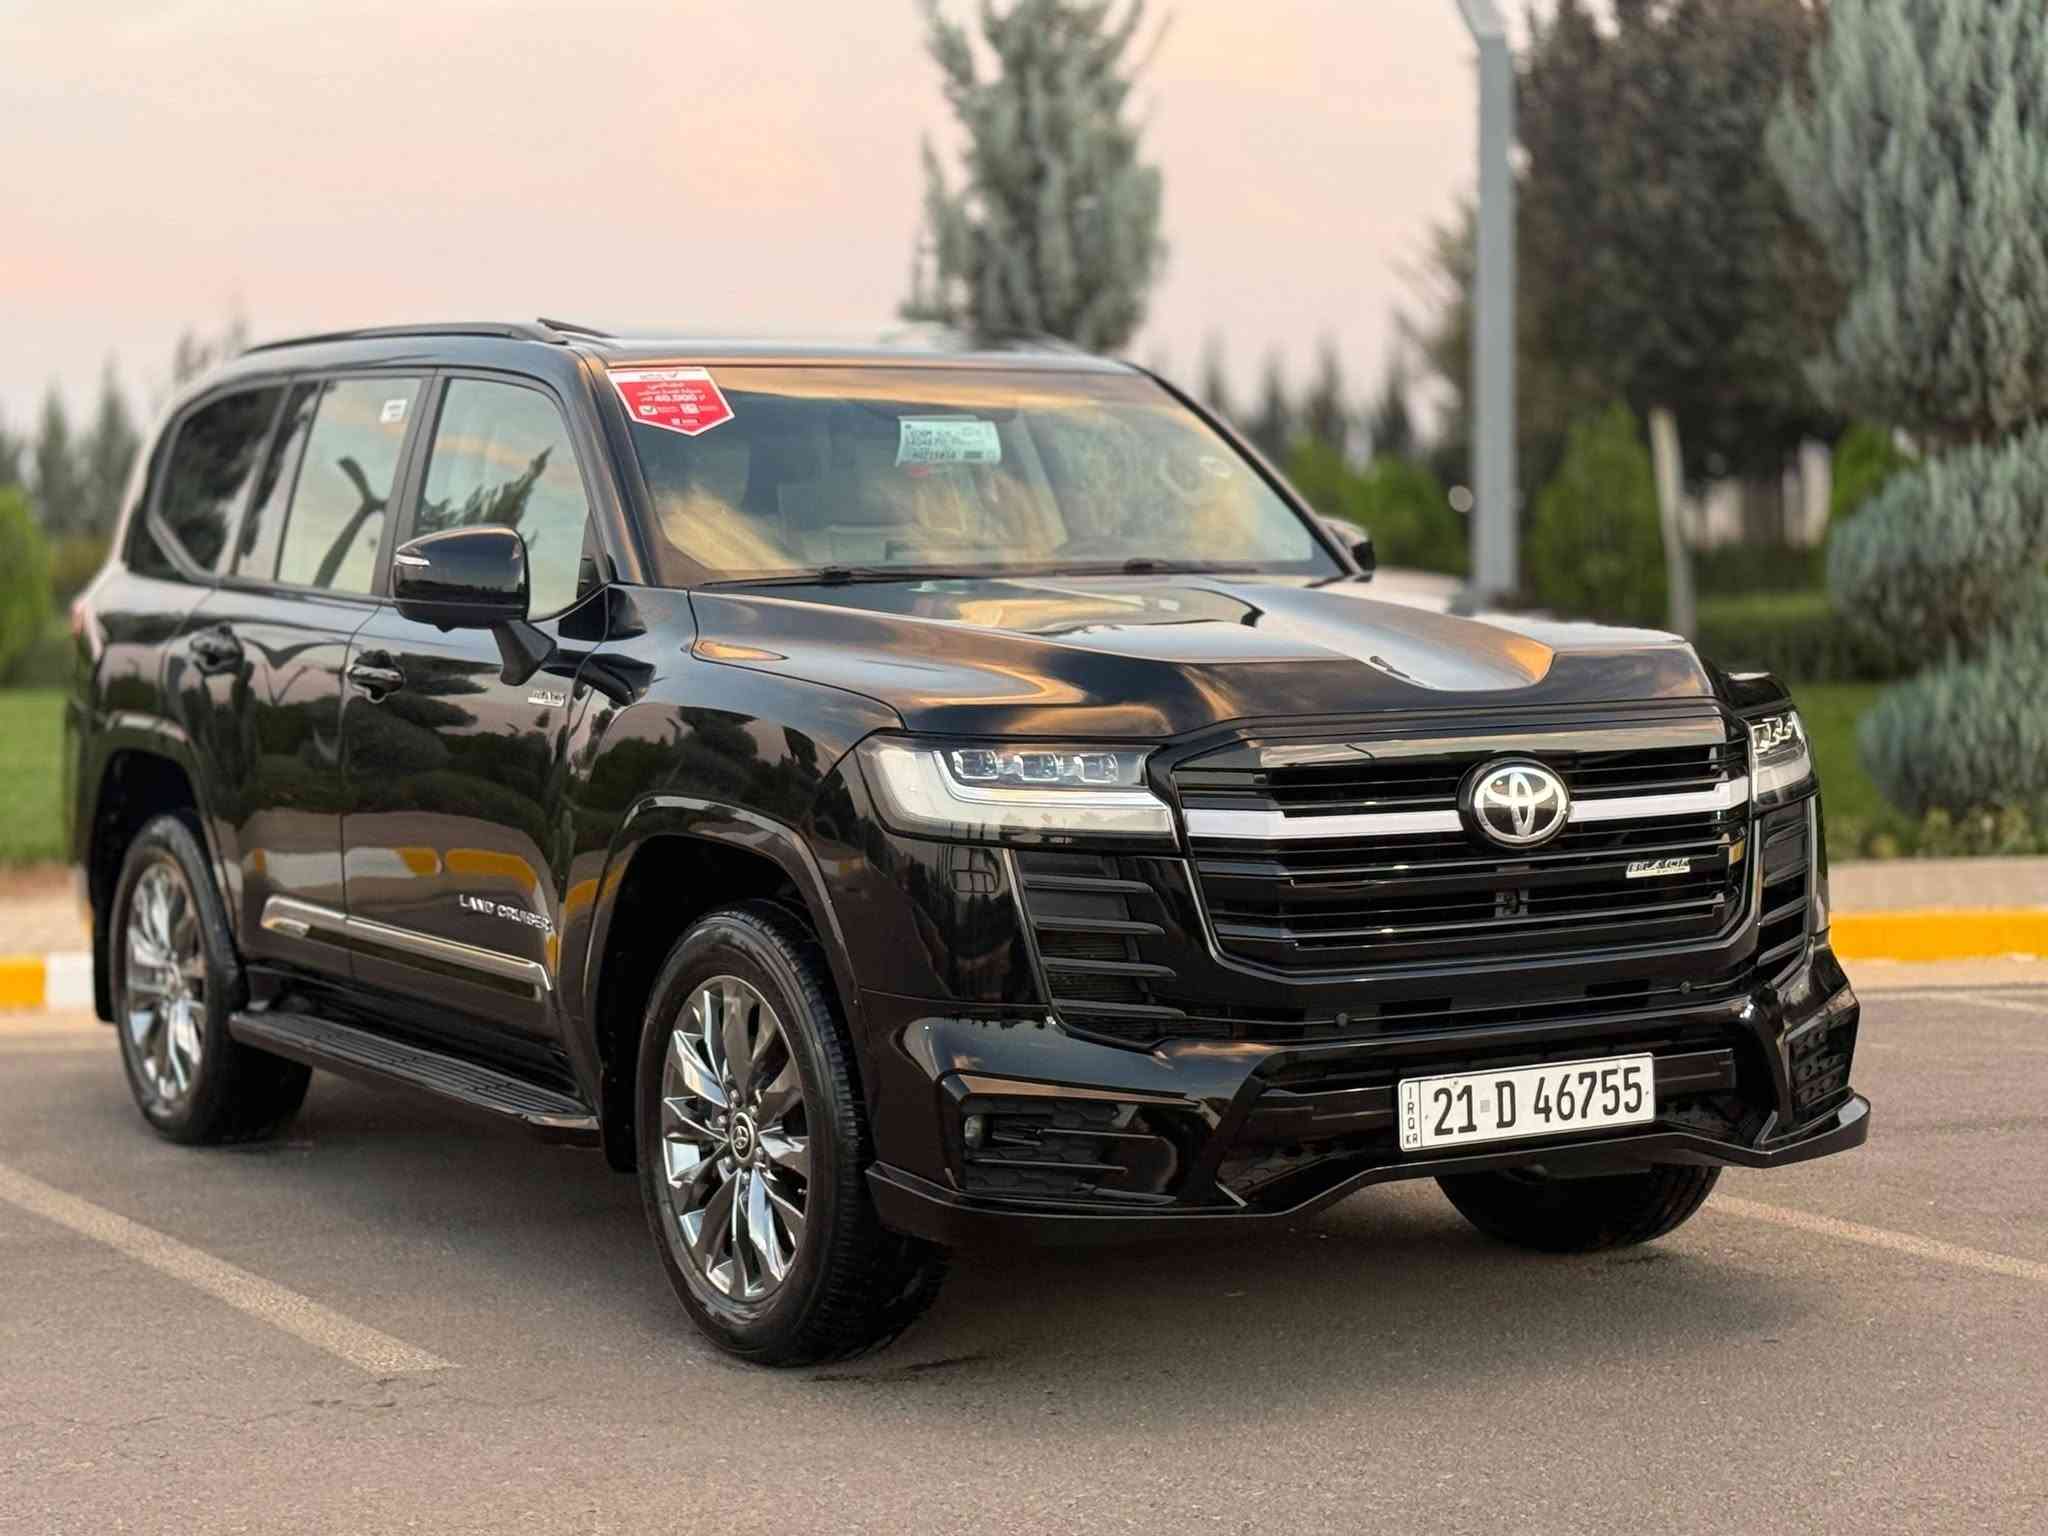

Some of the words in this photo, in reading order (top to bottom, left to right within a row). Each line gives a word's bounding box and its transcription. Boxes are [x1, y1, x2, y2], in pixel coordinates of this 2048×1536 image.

[459, 893, 495, 914] LAND
[497, 904, 553, 932] CRUISER
[1433, 1084, 1477, 1137] 21
[1495, 1080, 1517, 1129] D
[1533, 1066, 1643, 1123] 46755
